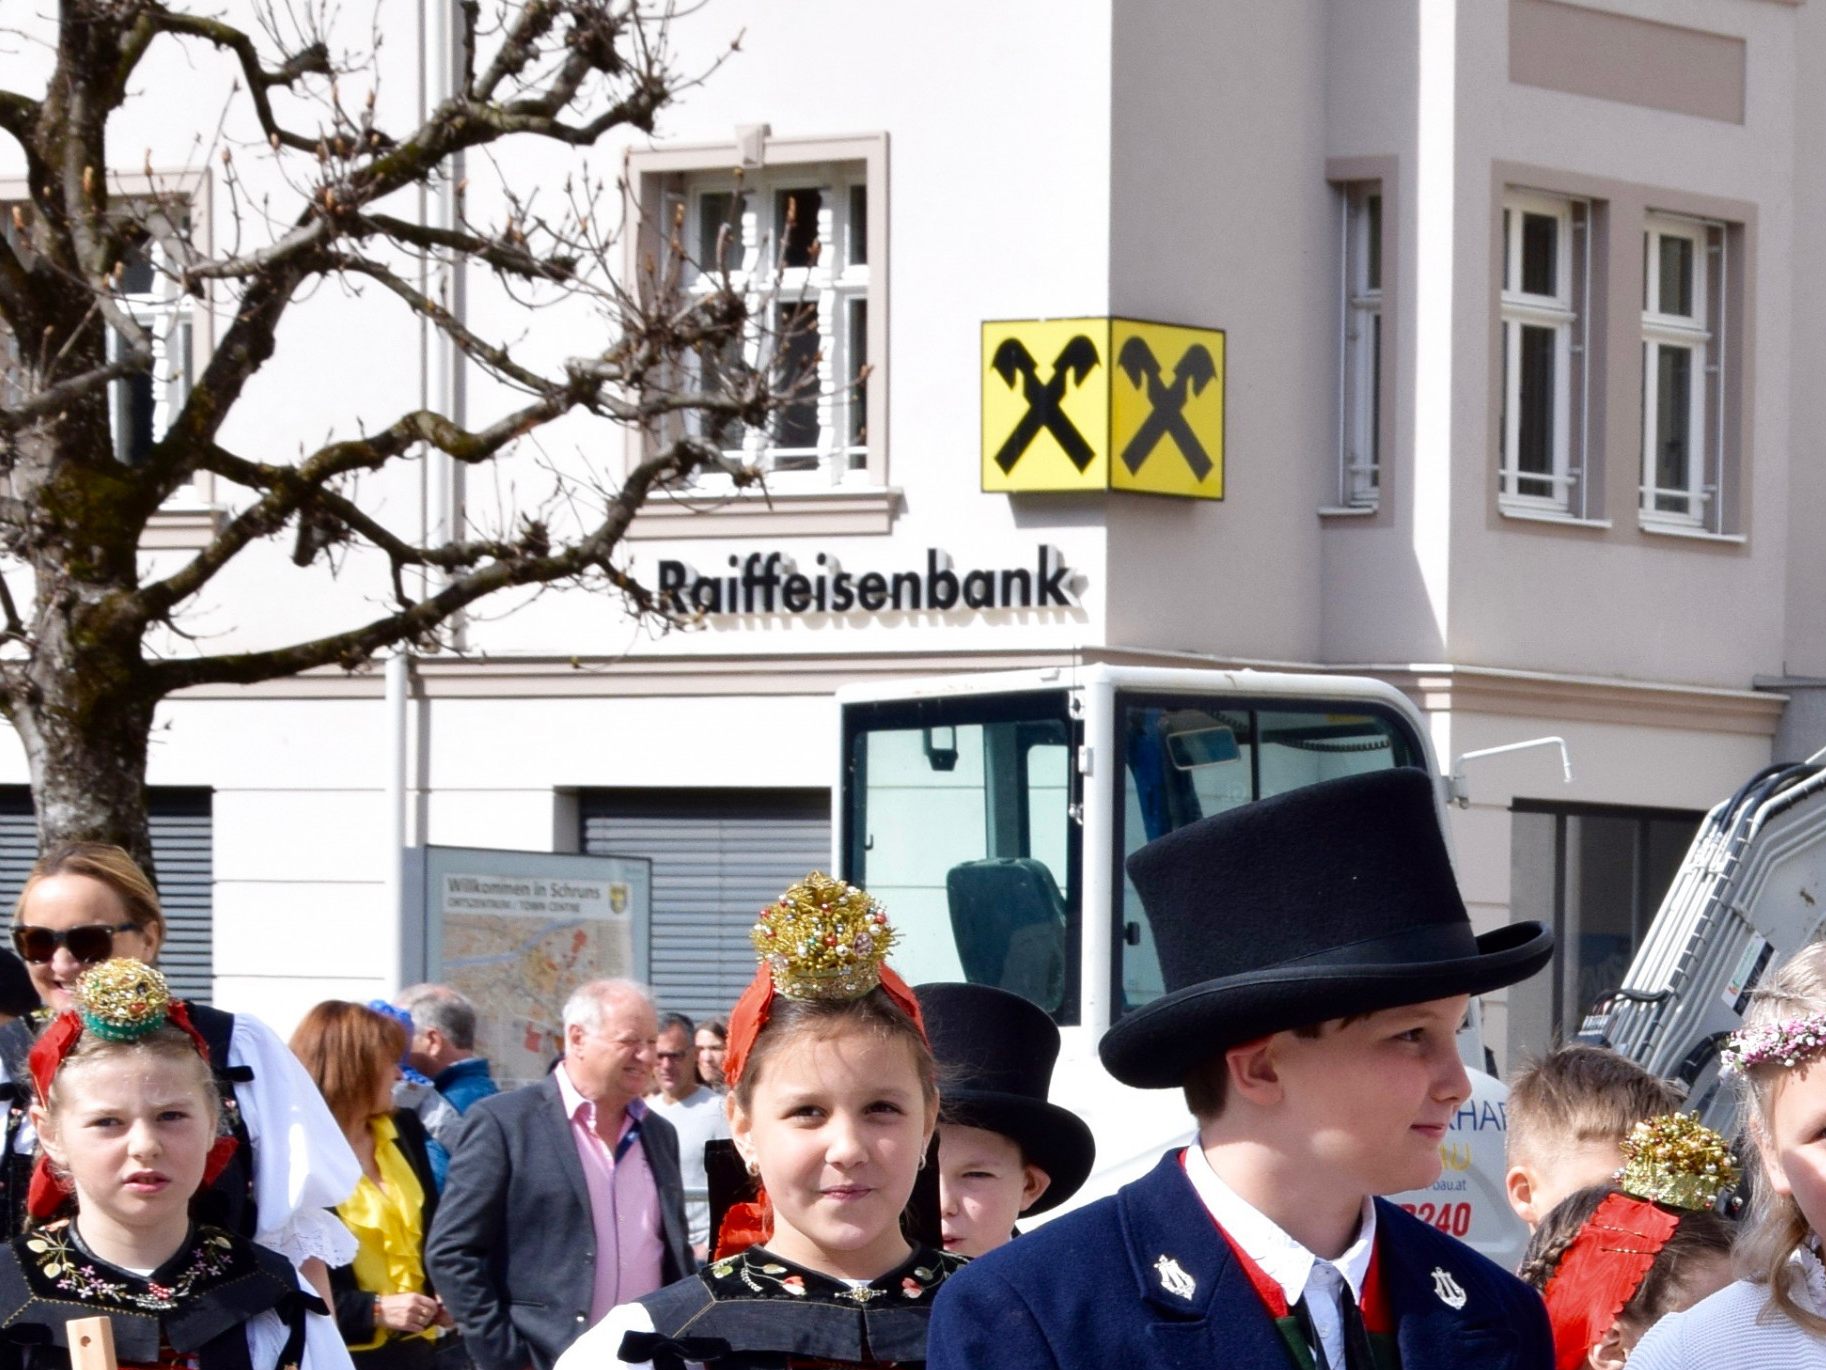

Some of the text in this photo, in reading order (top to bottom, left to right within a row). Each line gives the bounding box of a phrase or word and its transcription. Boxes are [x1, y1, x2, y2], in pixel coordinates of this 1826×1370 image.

[658, 544, 1073, 614] Raiffeisenbank
[448, 878, 600, 899] Willkommen in Schruns
